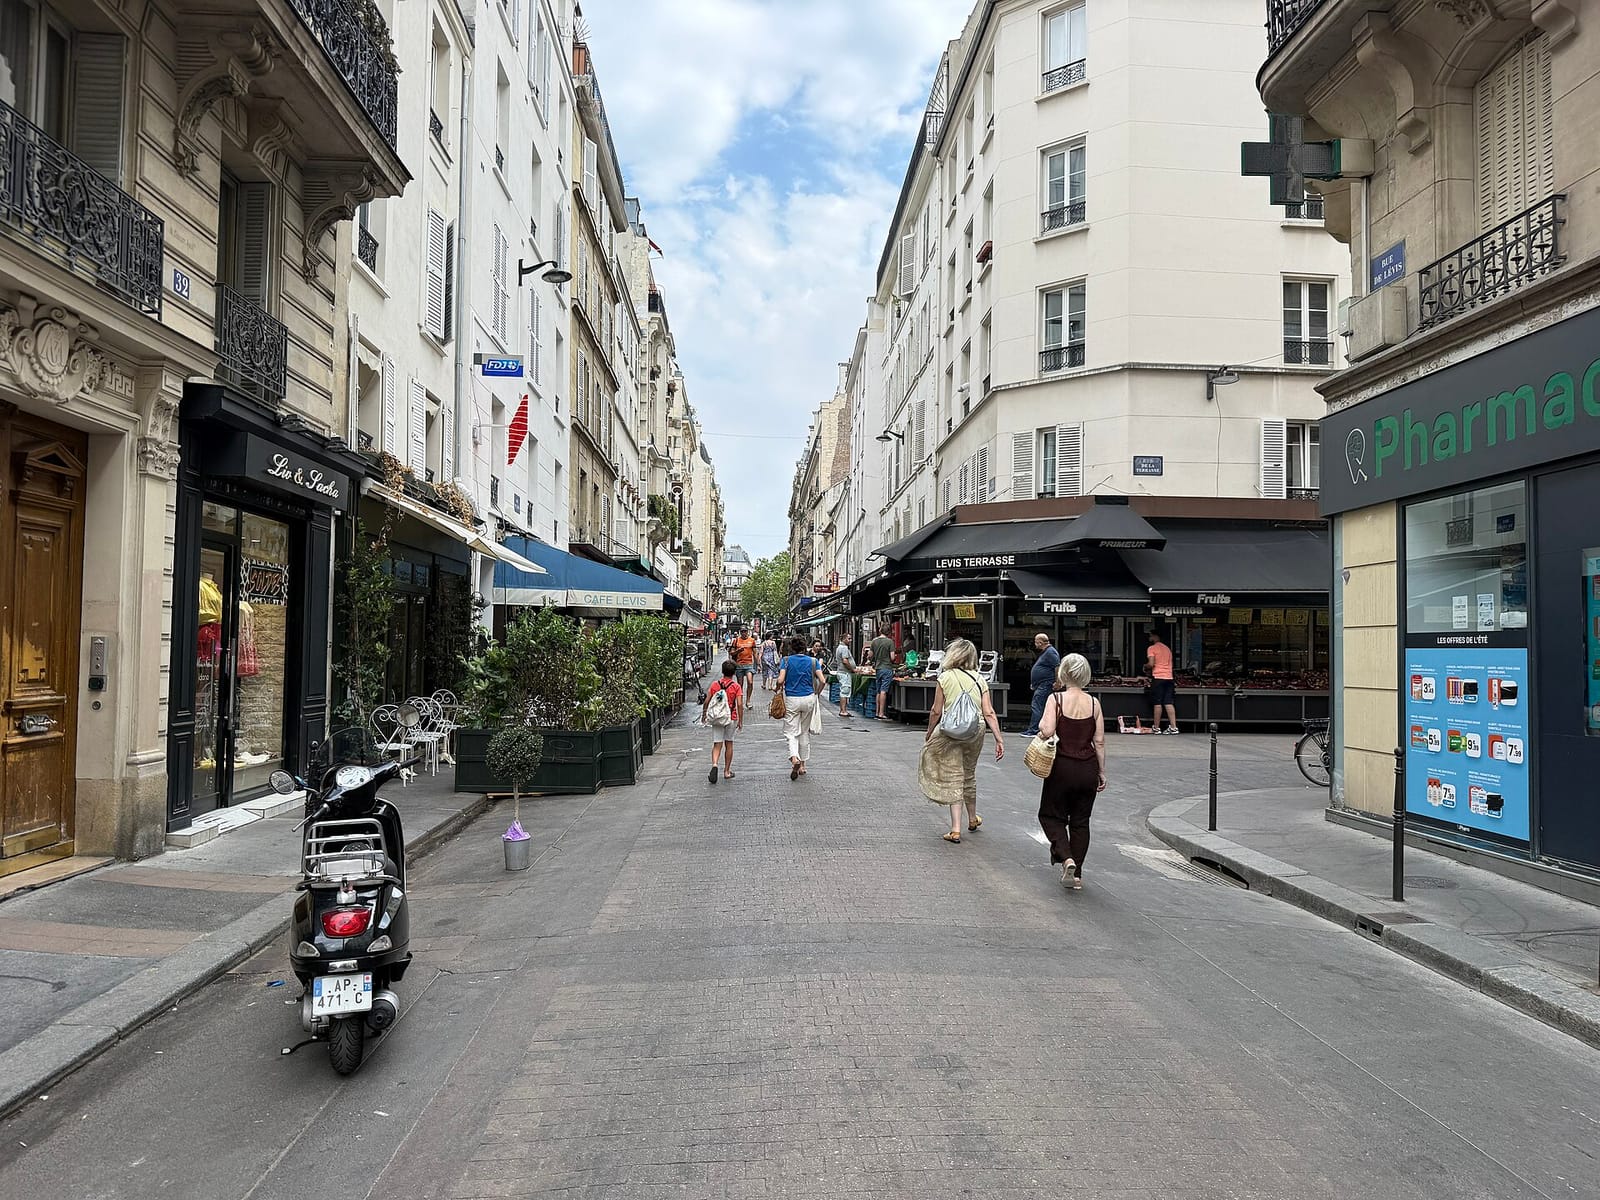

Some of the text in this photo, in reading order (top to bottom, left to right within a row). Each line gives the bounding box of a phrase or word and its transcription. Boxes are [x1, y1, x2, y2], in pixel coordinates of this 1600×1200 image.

[1381, 254, 1393, 268] RUE
[176, 272, 188, 297] 32
[488, 361, 507, 369] FDJ
[267, 454, 339, 498] Liv & Sacha
[936, 555, 1015, 568] LEVIS TERRASSE
[584, 594, 647, 606] CAFE LEVIS
[1197, 593, 1231, 604] Fruits
[1043, 601, 1076, 613] Fruits
[1436, 636, 1446, 644] LES
[1446, 636, 1466, 644] OFFRES
[1466, 636, 1474, 644] DE
